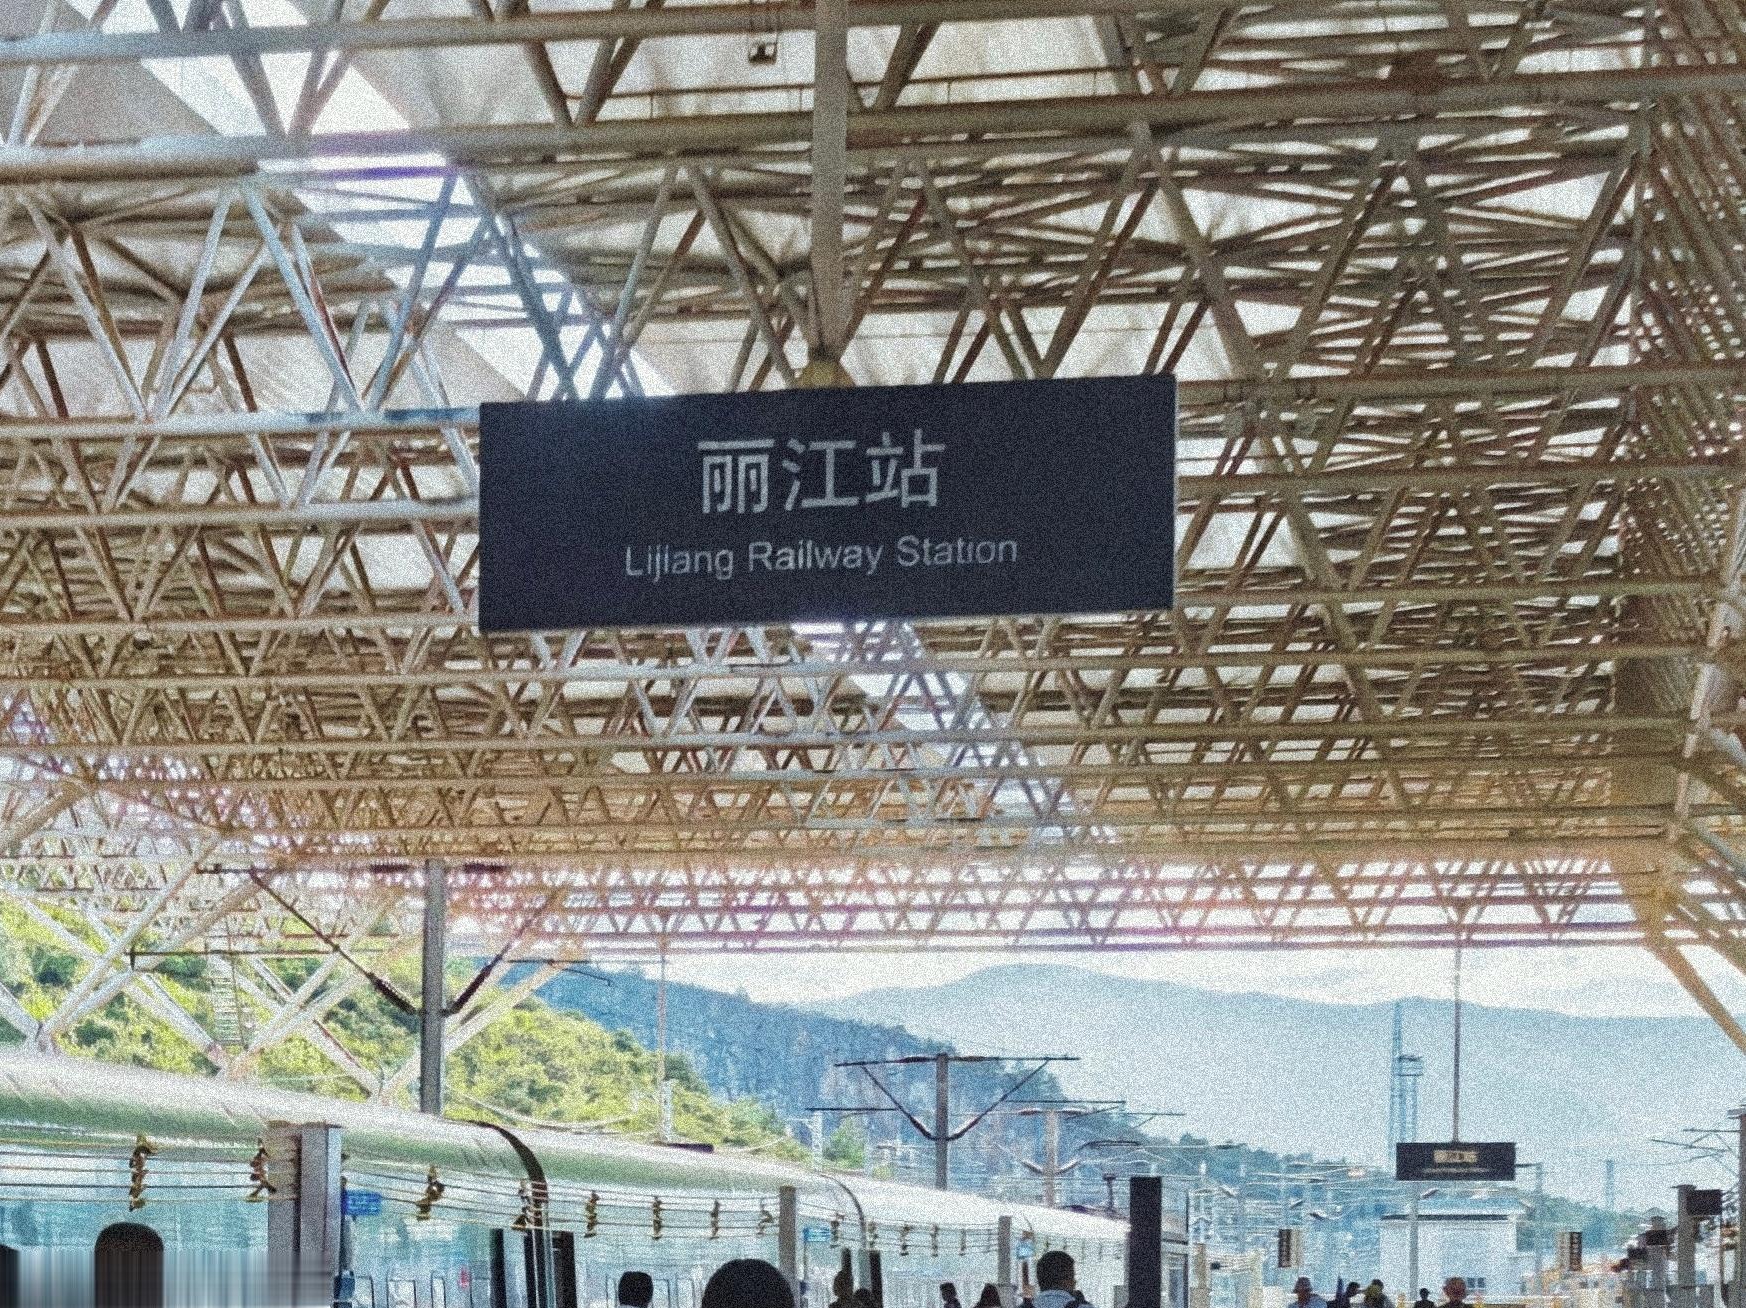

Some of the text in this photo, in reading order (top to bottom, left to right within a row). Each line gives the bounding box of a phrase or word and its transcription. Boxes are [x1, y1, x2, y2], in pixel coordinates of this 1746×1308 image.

[696, 428, 946, 514] 丽江站
[625, 534, 1018, 583] Lijiang Railway Station
